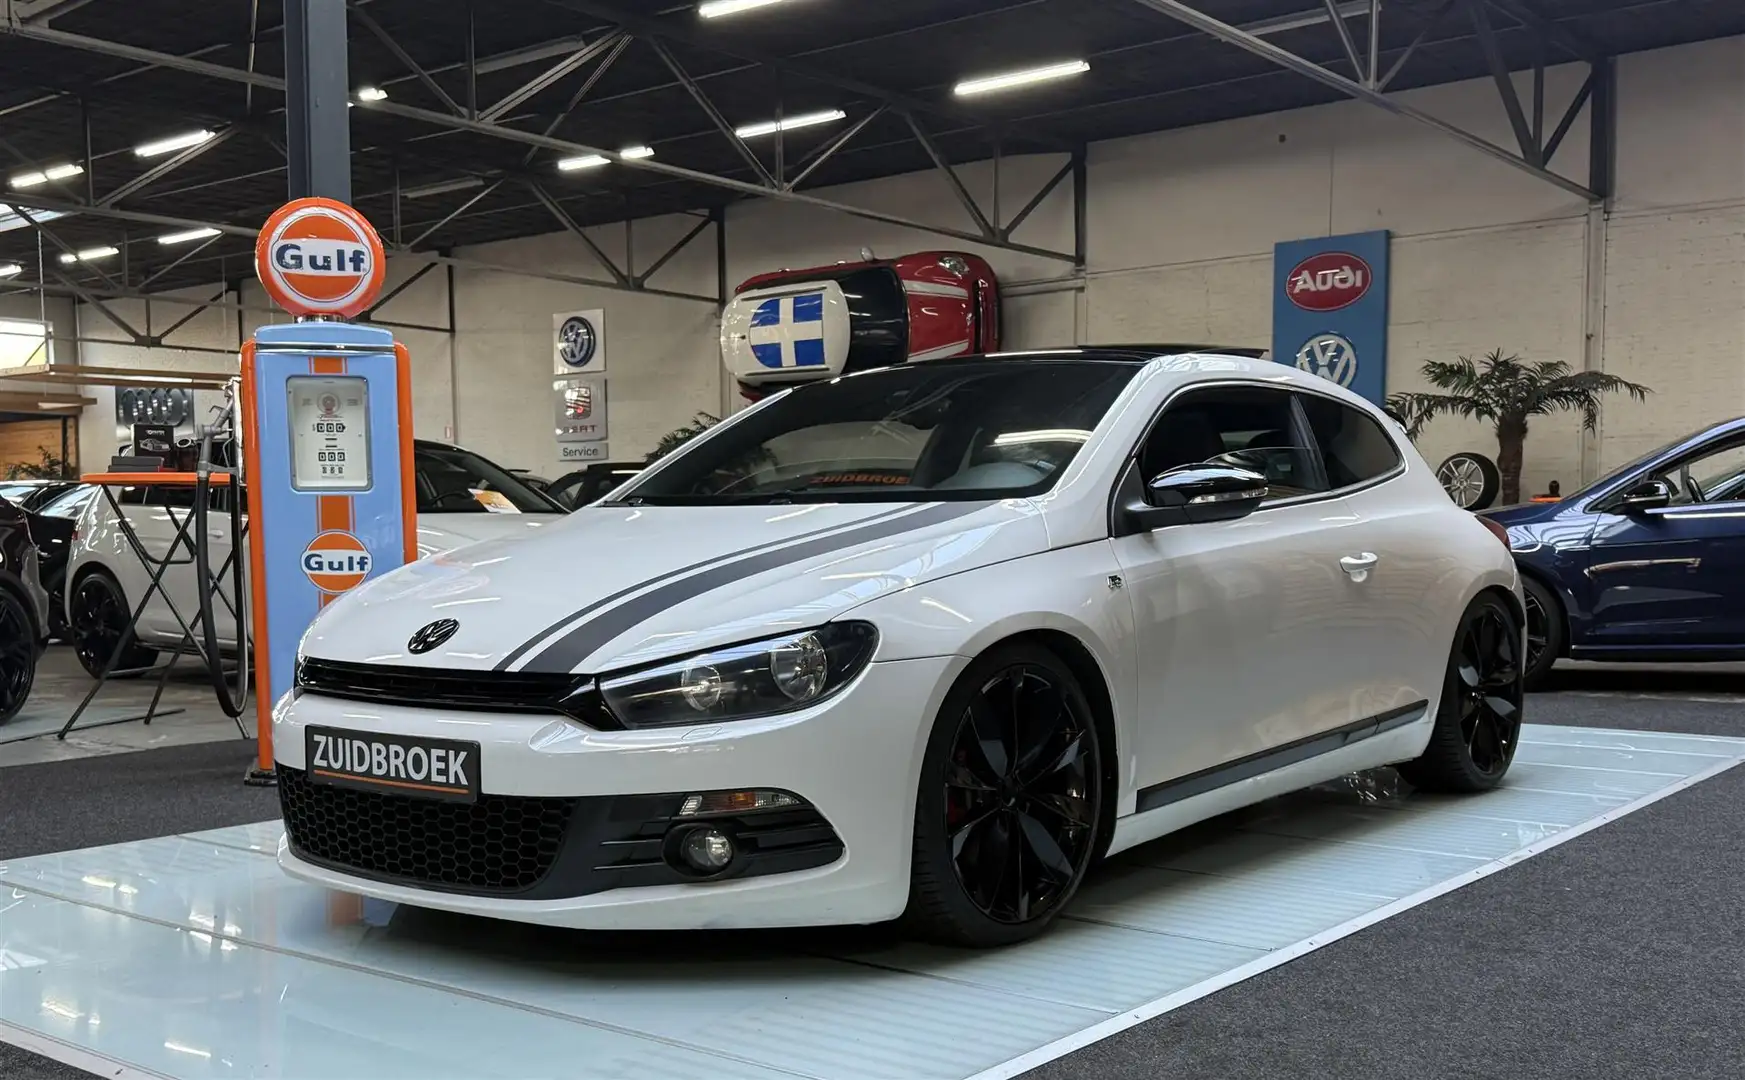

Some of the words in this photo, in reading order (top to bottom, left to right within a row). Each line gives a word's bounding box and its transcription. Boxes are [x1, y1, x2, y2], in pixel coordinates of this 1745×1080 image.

[276, 244, 365, 271] Gulf
[562, 447, 599, 457] Service
[810, 474, 911, 485] ZUIDBROE
[304, 553, 369, 572] Gulf
[313, 734, 468, 785] ZUIDBROEK
